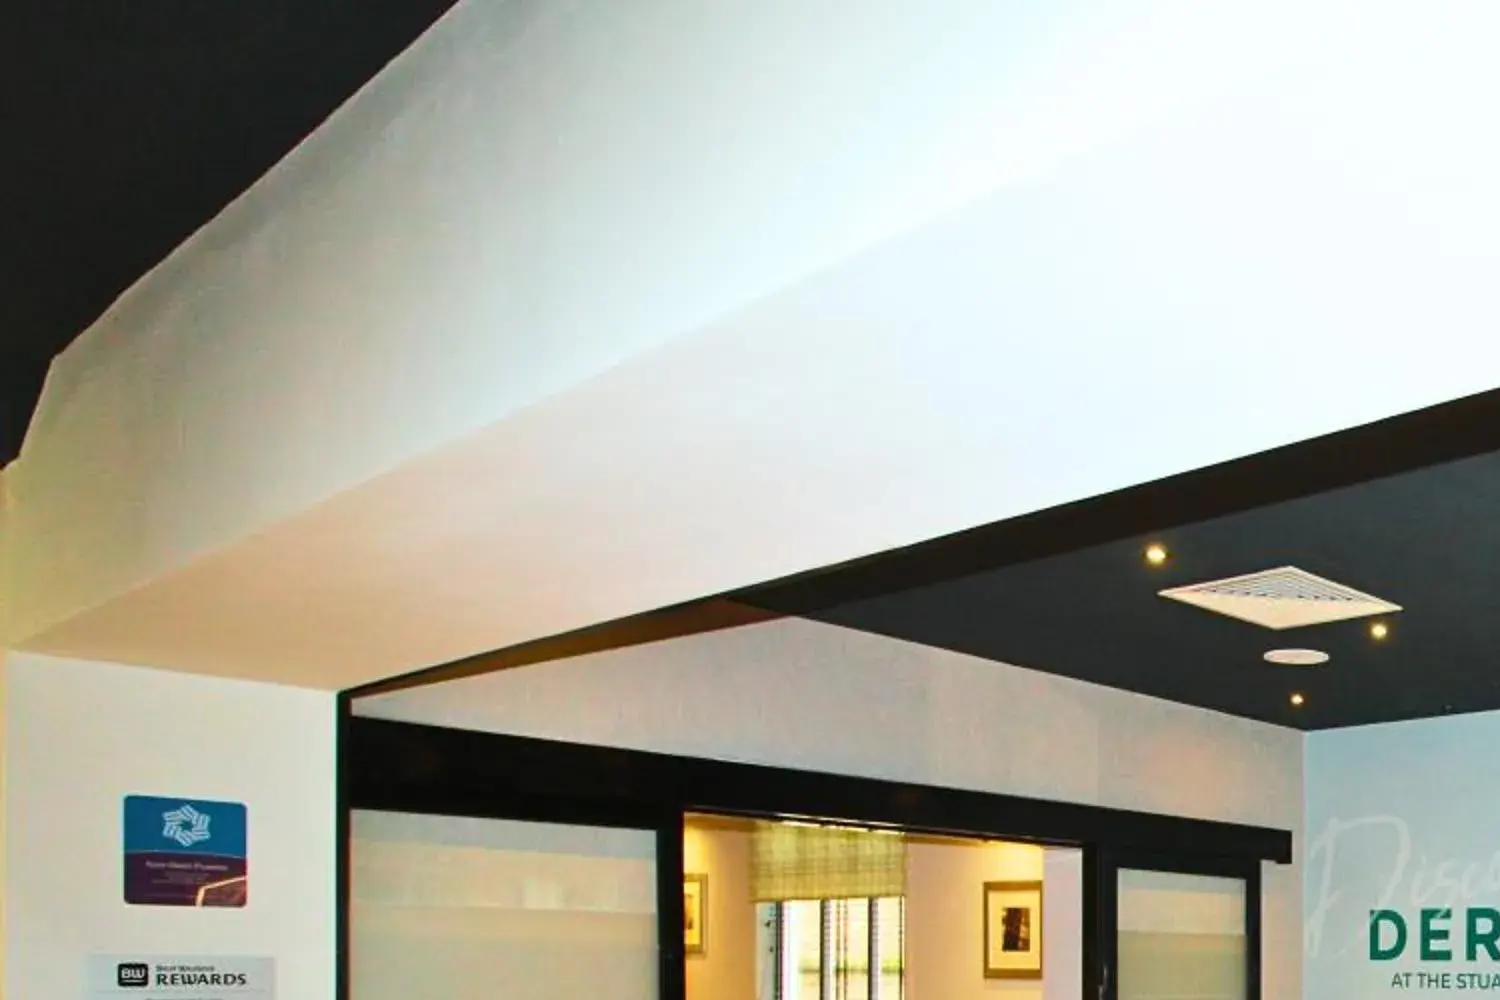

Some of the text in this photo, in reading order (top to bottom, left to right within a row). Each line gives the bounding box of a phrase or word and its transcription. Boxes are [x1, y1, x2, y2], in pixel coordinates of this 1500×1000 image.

[120, 967, 146, 980] BW
[156, 973, 247, 986] REWARDS
[1391, 972, 1412, 989] AT
[1417, 972, 1452, 990] THE
